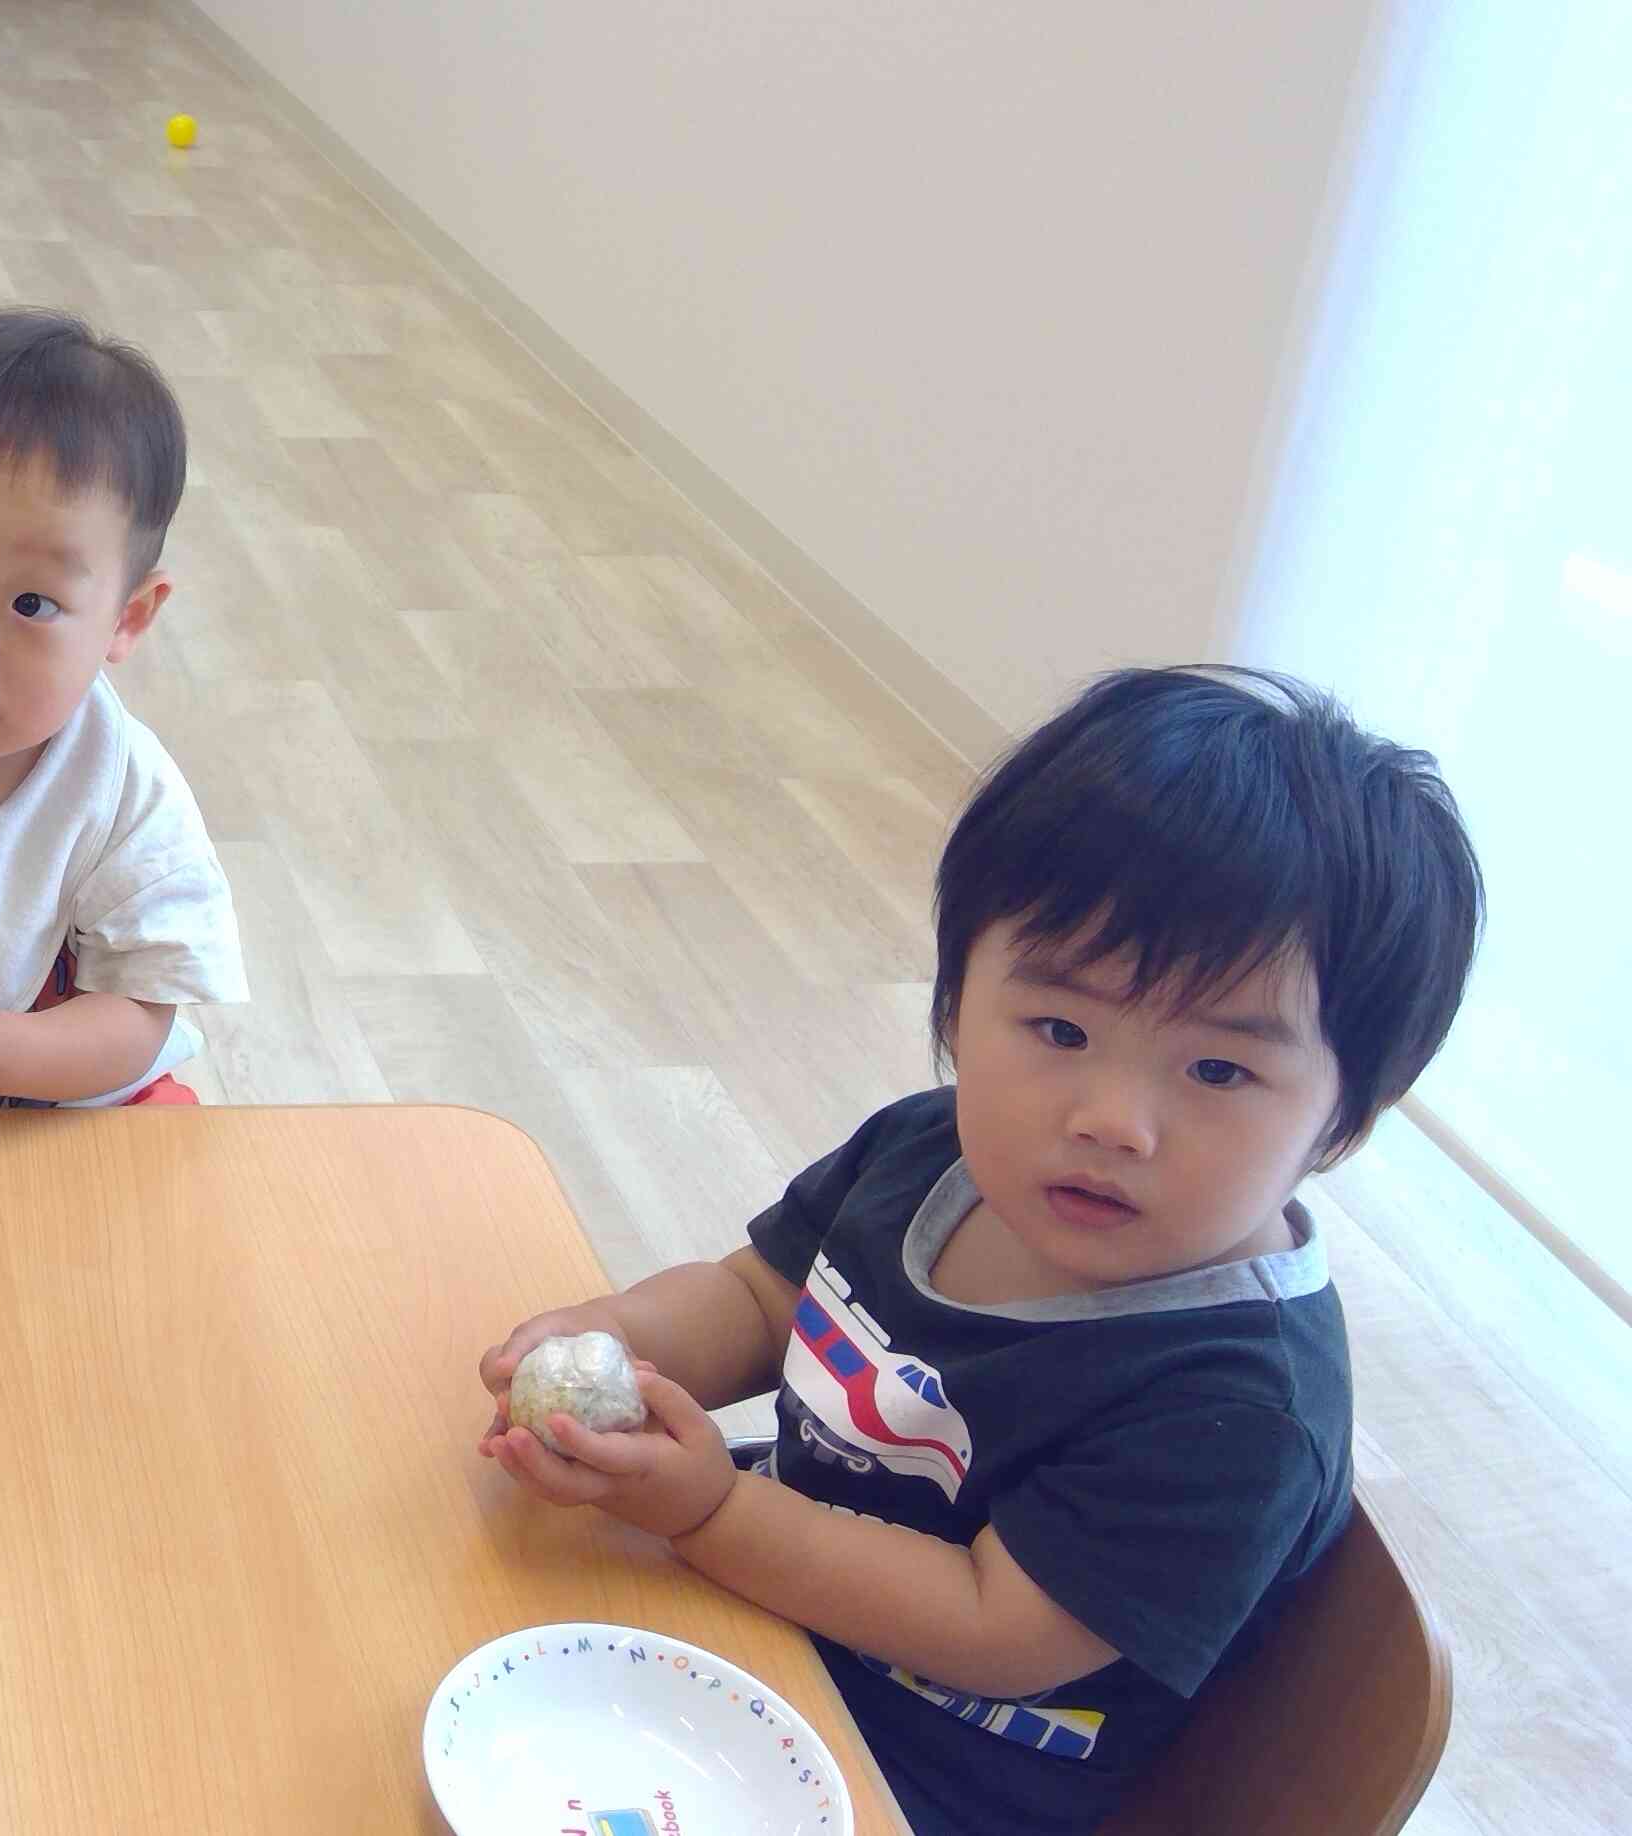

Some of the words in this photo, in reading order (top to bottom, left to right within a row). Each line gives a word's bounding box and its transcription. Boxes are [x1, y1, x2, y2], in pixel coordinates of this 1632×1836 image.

[502, 1657, 516, 1674] K
[577, 1636, 593, 1653] M
[629, 1646, 647, 1665] N
[673, 1655, 689, 1670] O
[707, 1678, 722, 1690] P
[749, 1699, 765, 1719] Q
[781, 1737, 795, 1750] R
[798, 1768, 812, 1783] S
